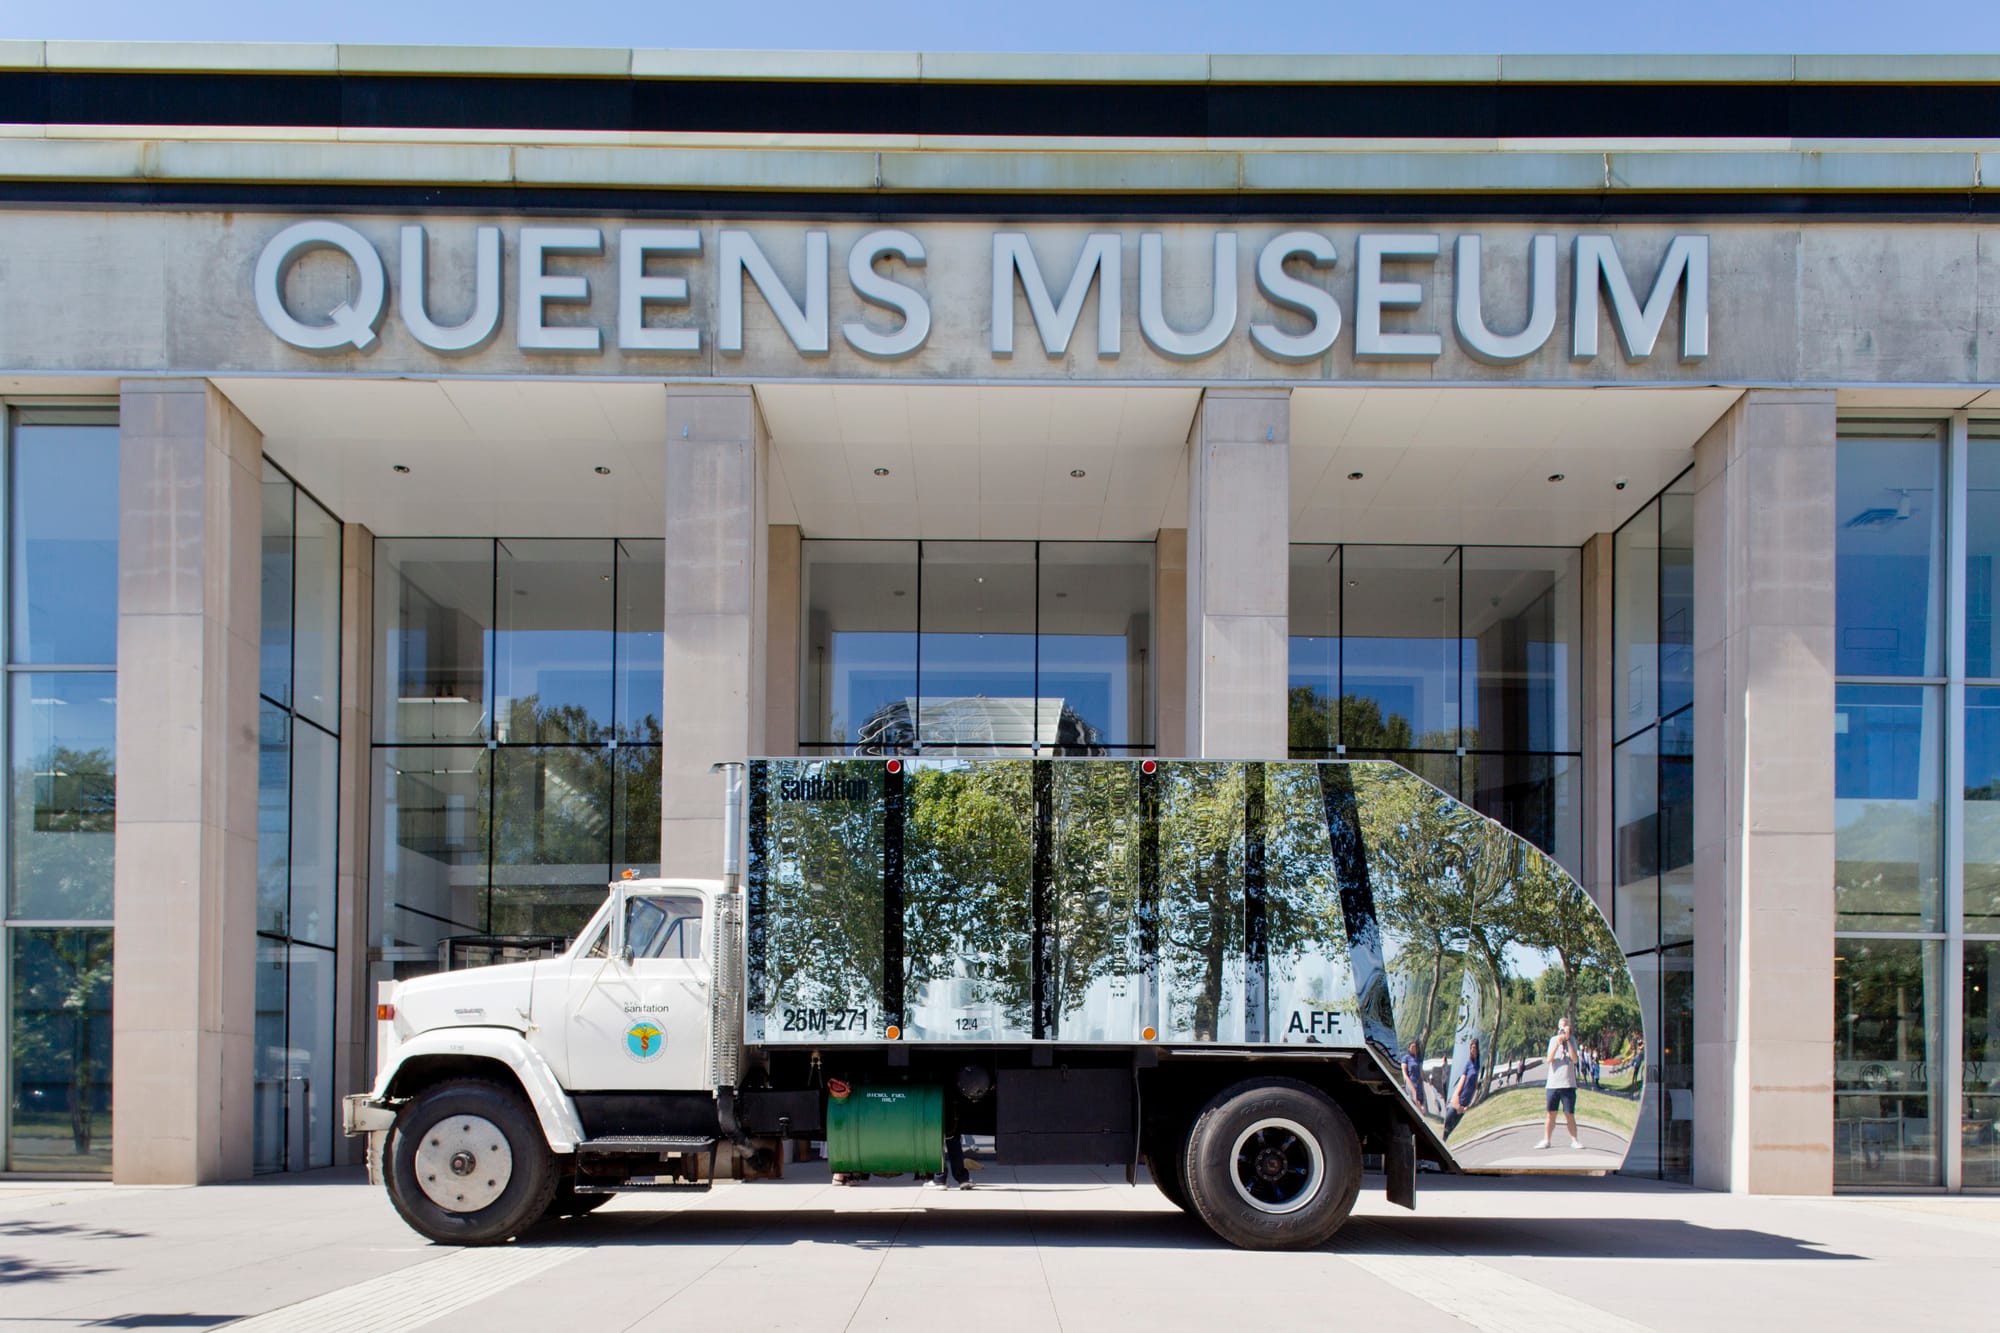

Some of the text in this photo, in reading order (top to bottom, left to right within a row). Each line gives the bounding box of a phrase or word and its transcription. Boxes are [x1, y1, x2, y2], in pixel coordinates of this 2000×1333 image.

[254, 220, 1710, 364] QUEENS MUSEUM
[781, 774, 868, 800] sanitation
[624, 1004, 669, 1013] sanitation
[783, 1008, 868, 1032] 25M-271
[1288, 1011, 1342, 1034] A.F.F.
